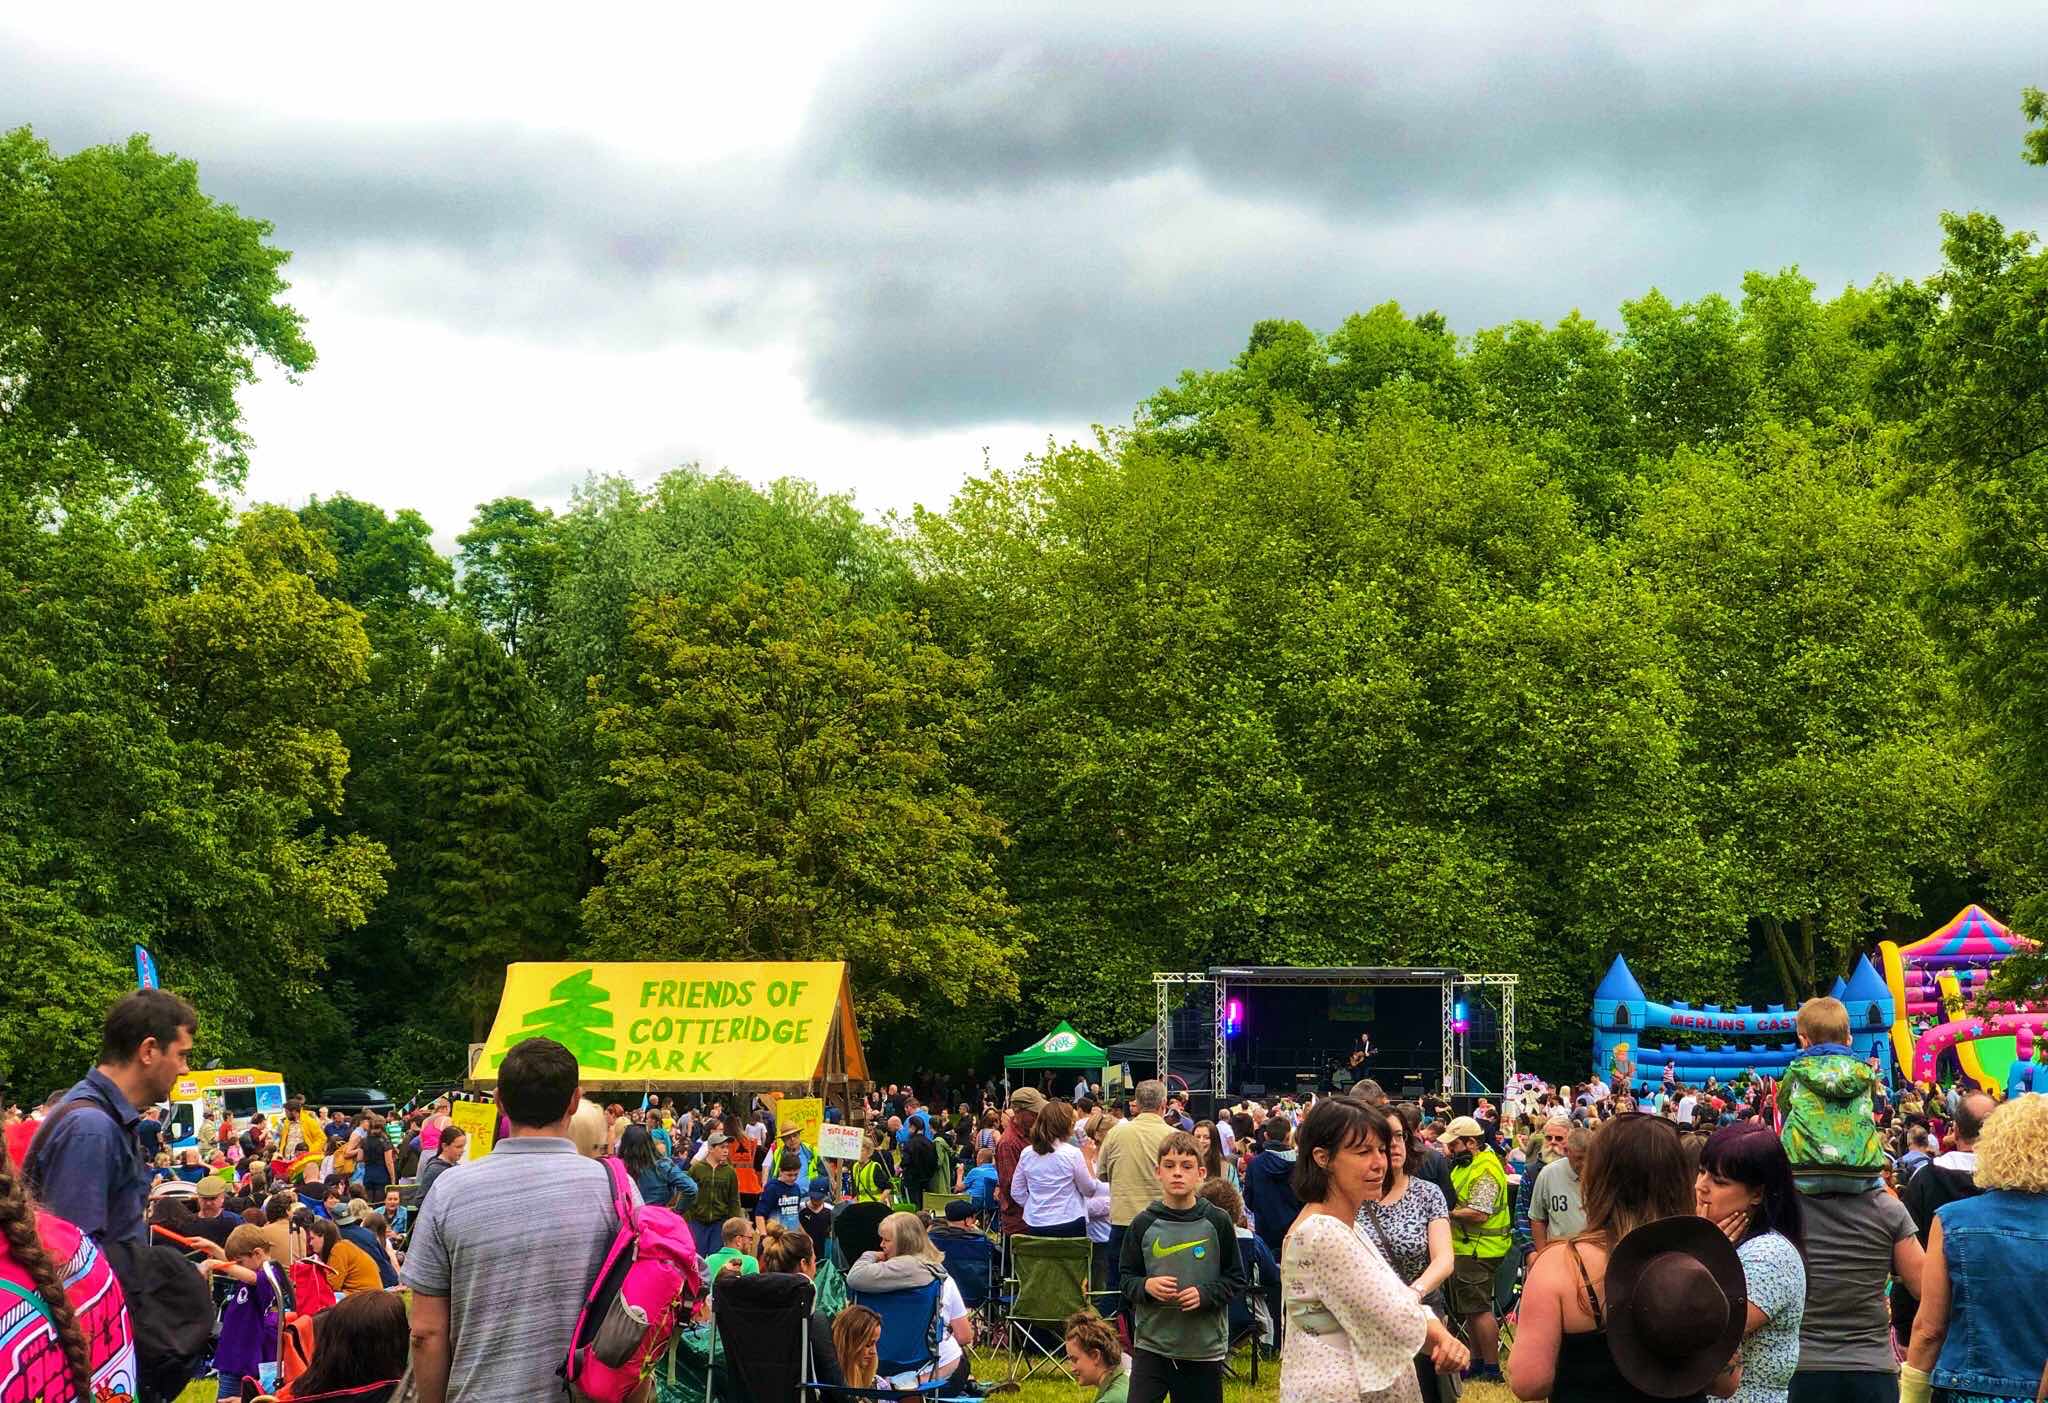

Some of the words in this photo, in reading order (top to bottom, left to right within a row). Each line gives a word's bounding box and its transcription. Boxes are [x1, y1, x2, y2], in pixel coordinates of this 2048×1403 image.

[640, 980, 756, 1008] FRIENDS
[767, 980, 808, 1008] OF
[629, 1016, 812, 1045] COTTERIDGE
[1670, 1014, 1745, 1031] MERLINS
[622, 1048, 713, 1073] PARK
[1551, 1194, 1568, 1212] 03
